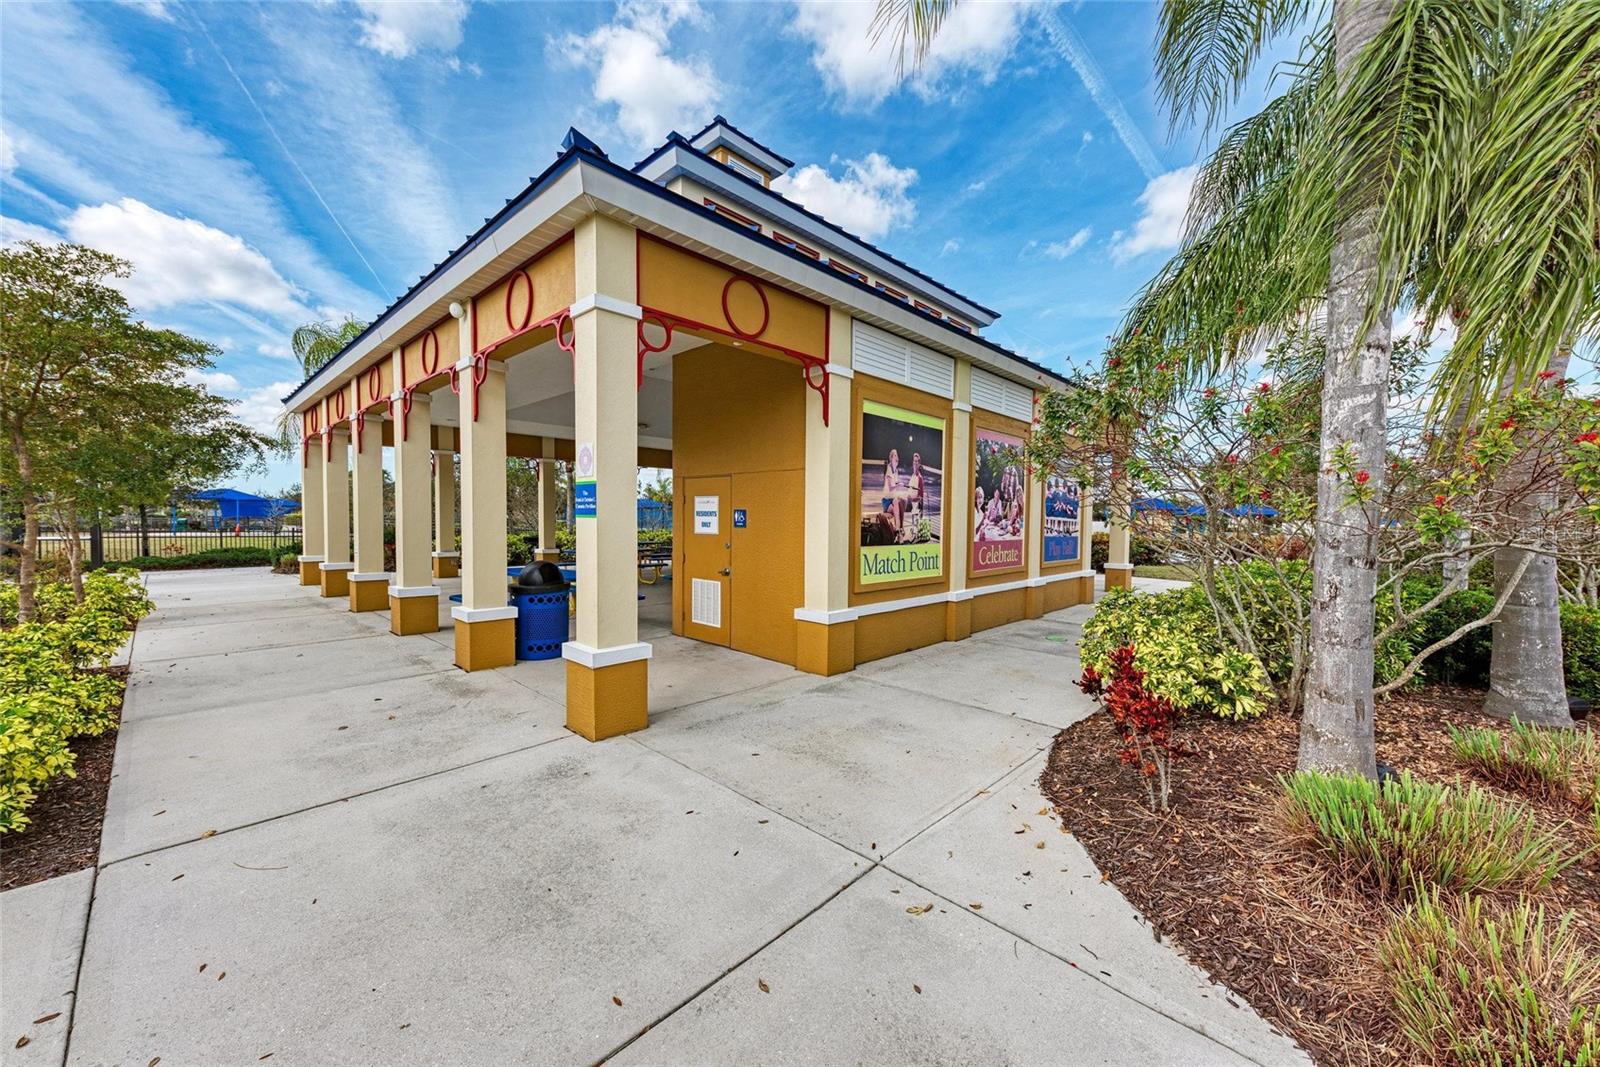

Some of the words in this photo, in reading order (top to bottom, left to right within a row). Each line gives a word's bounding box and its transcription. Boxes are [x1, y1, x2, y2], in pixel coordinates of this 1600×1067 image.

[863, 550, 906, 576] Match
[909, 551, 939, 572] Point
[978, 544, 1019, 566] Celebrate
